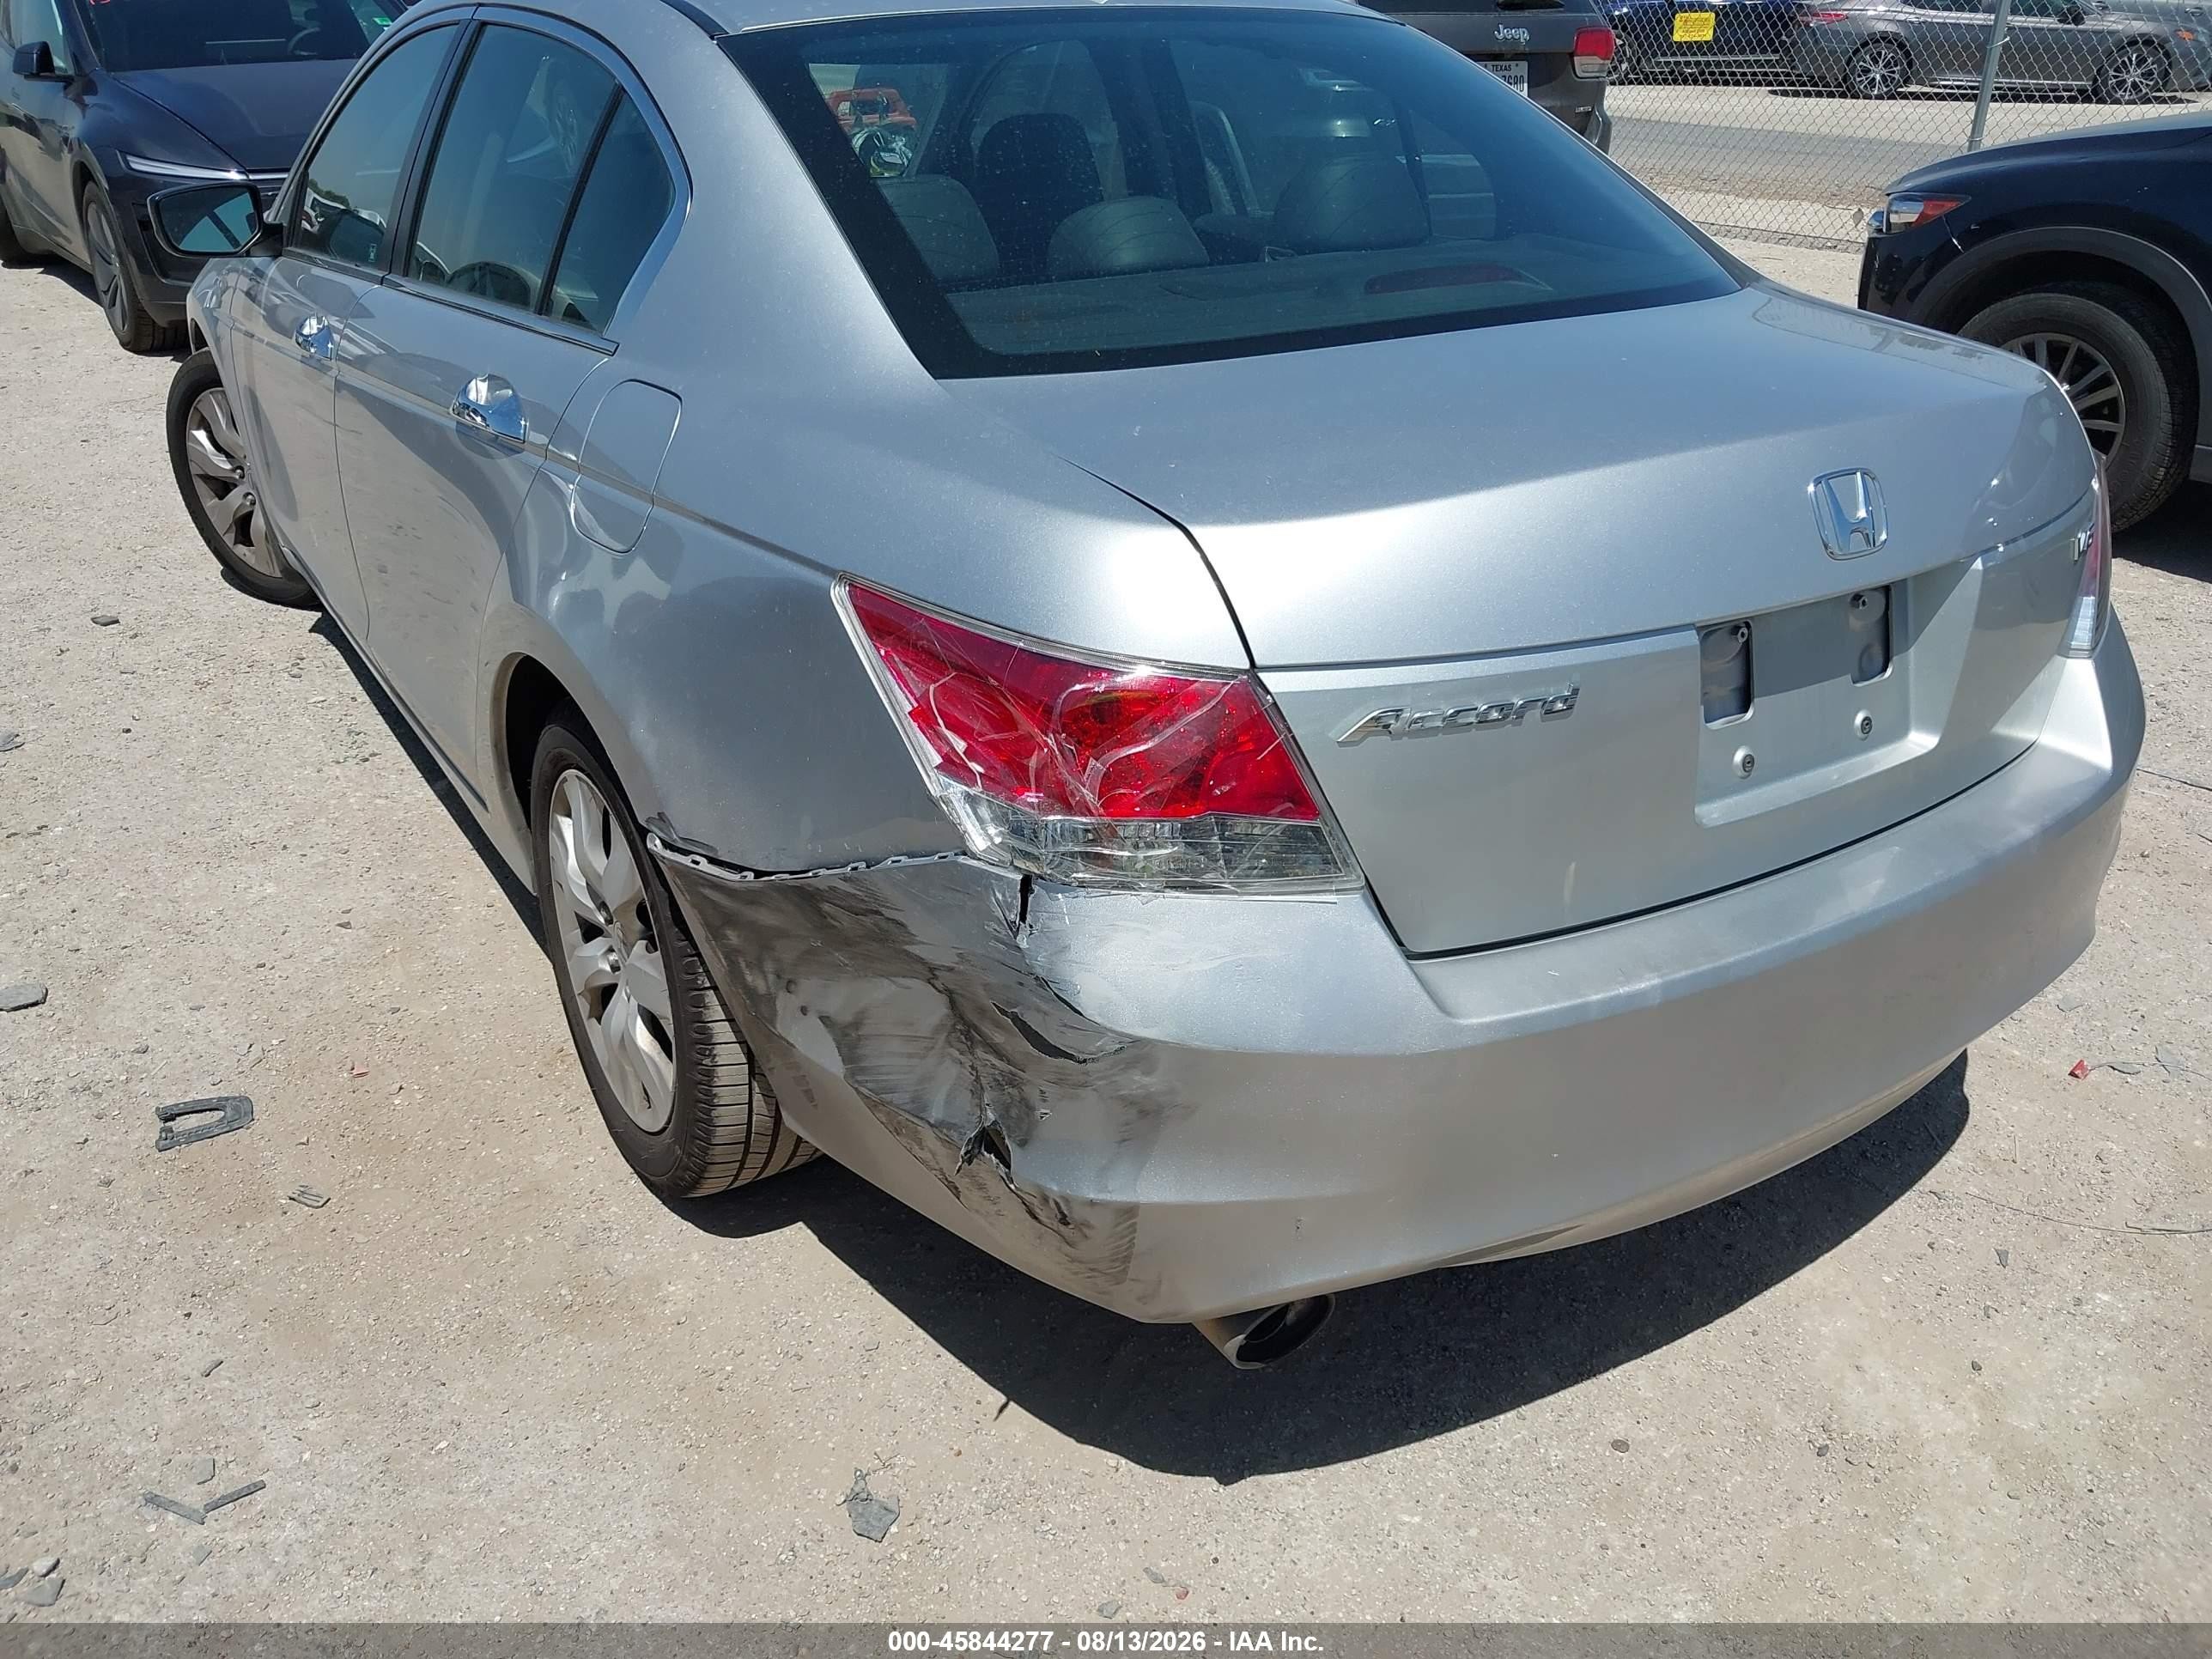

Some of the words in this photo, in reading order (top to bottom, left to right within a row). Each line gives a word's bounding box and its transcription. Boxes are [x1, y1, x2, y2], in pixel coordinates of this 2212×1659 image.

[1494, 24, 1530, 45] Jeep
[1492, 64, 1511, 72] TEXAS
[1336, 684, 1580, 742] Accord
